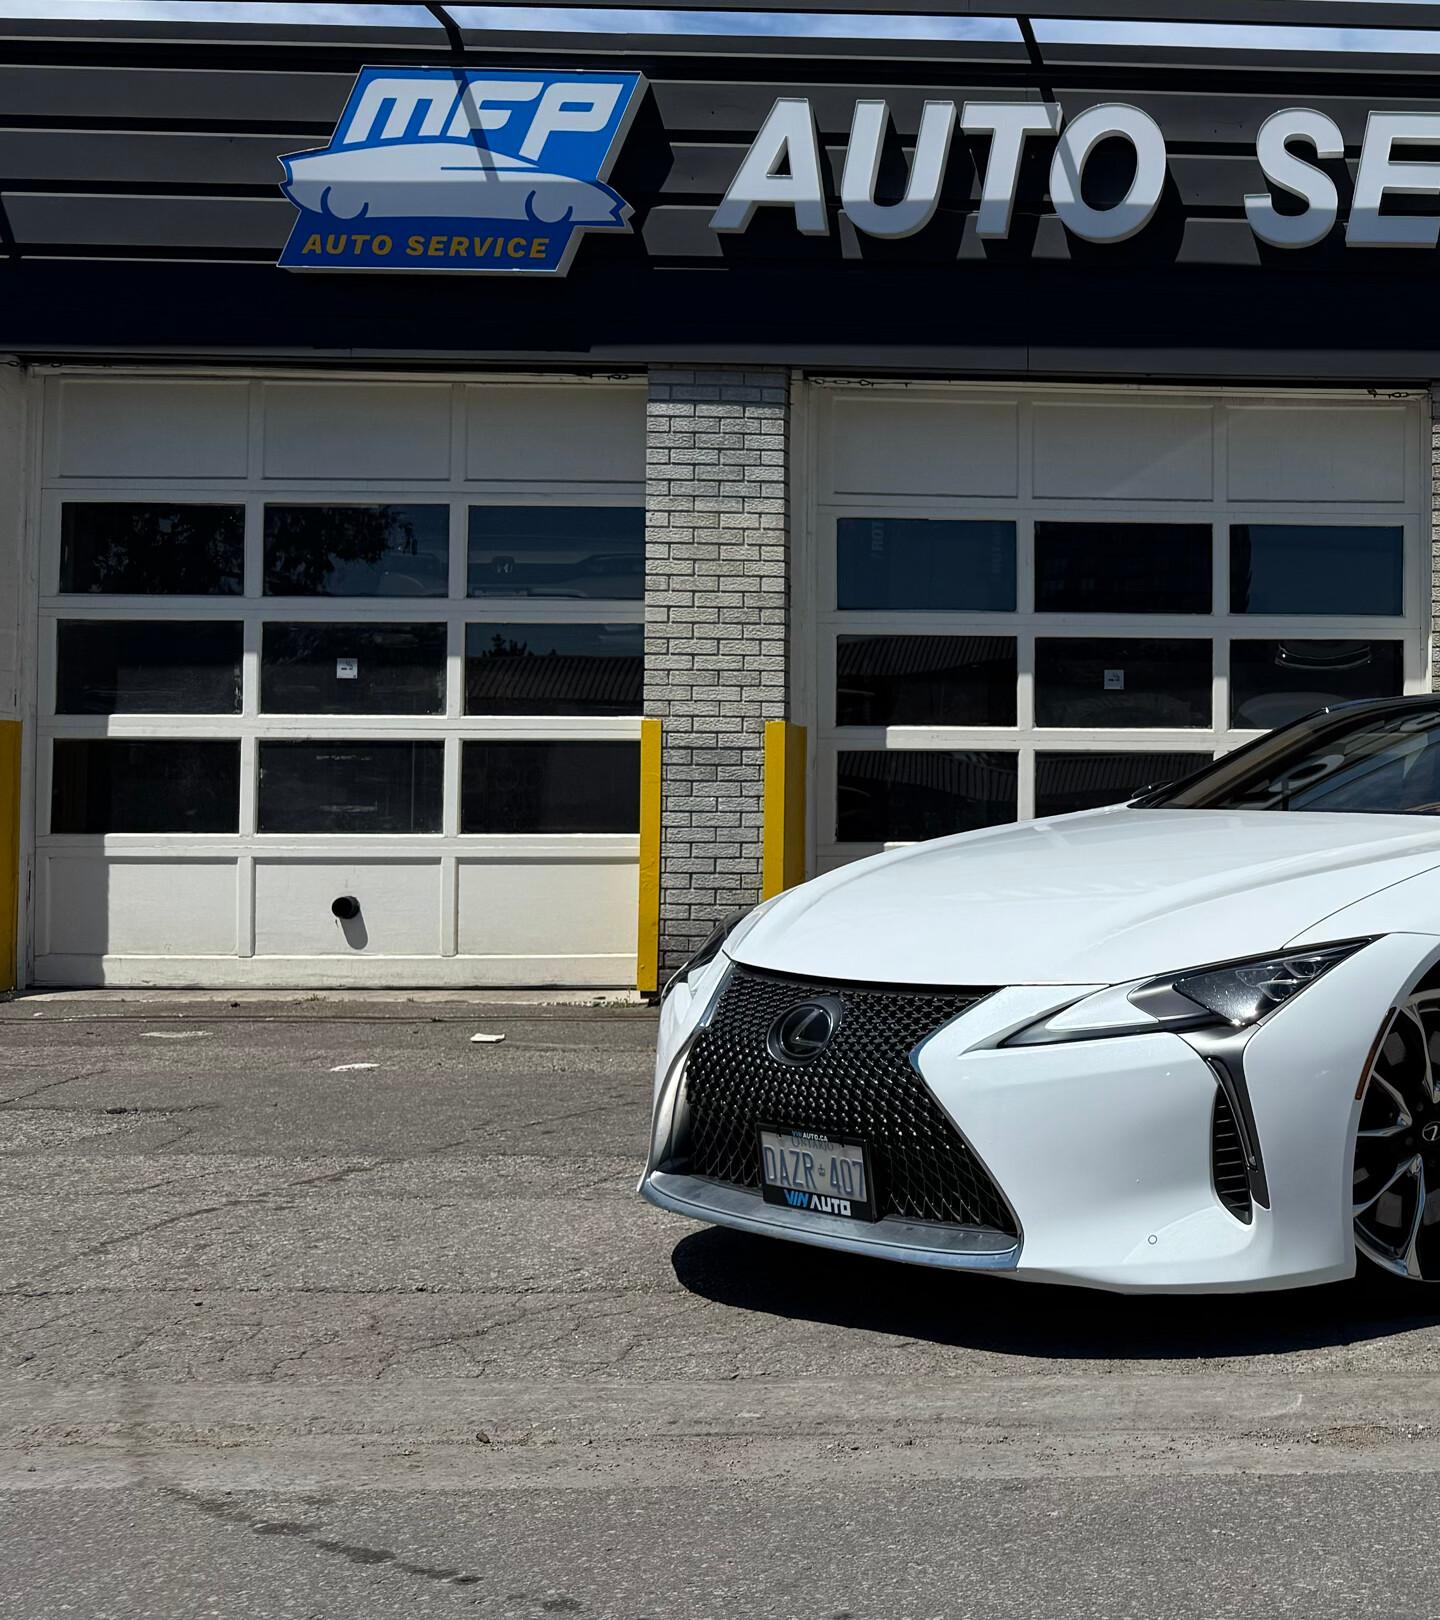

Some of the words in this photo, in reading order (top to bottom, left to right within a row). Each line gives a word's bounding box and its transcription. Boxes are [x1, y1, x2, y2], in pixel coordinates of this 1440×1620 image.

[343, 78, 624, 162] MFP
[708, 97, 1167, 243] AUTO
[302, 233, 393, 257] AUTO
[405, 234, 550, 259] SERVICE
